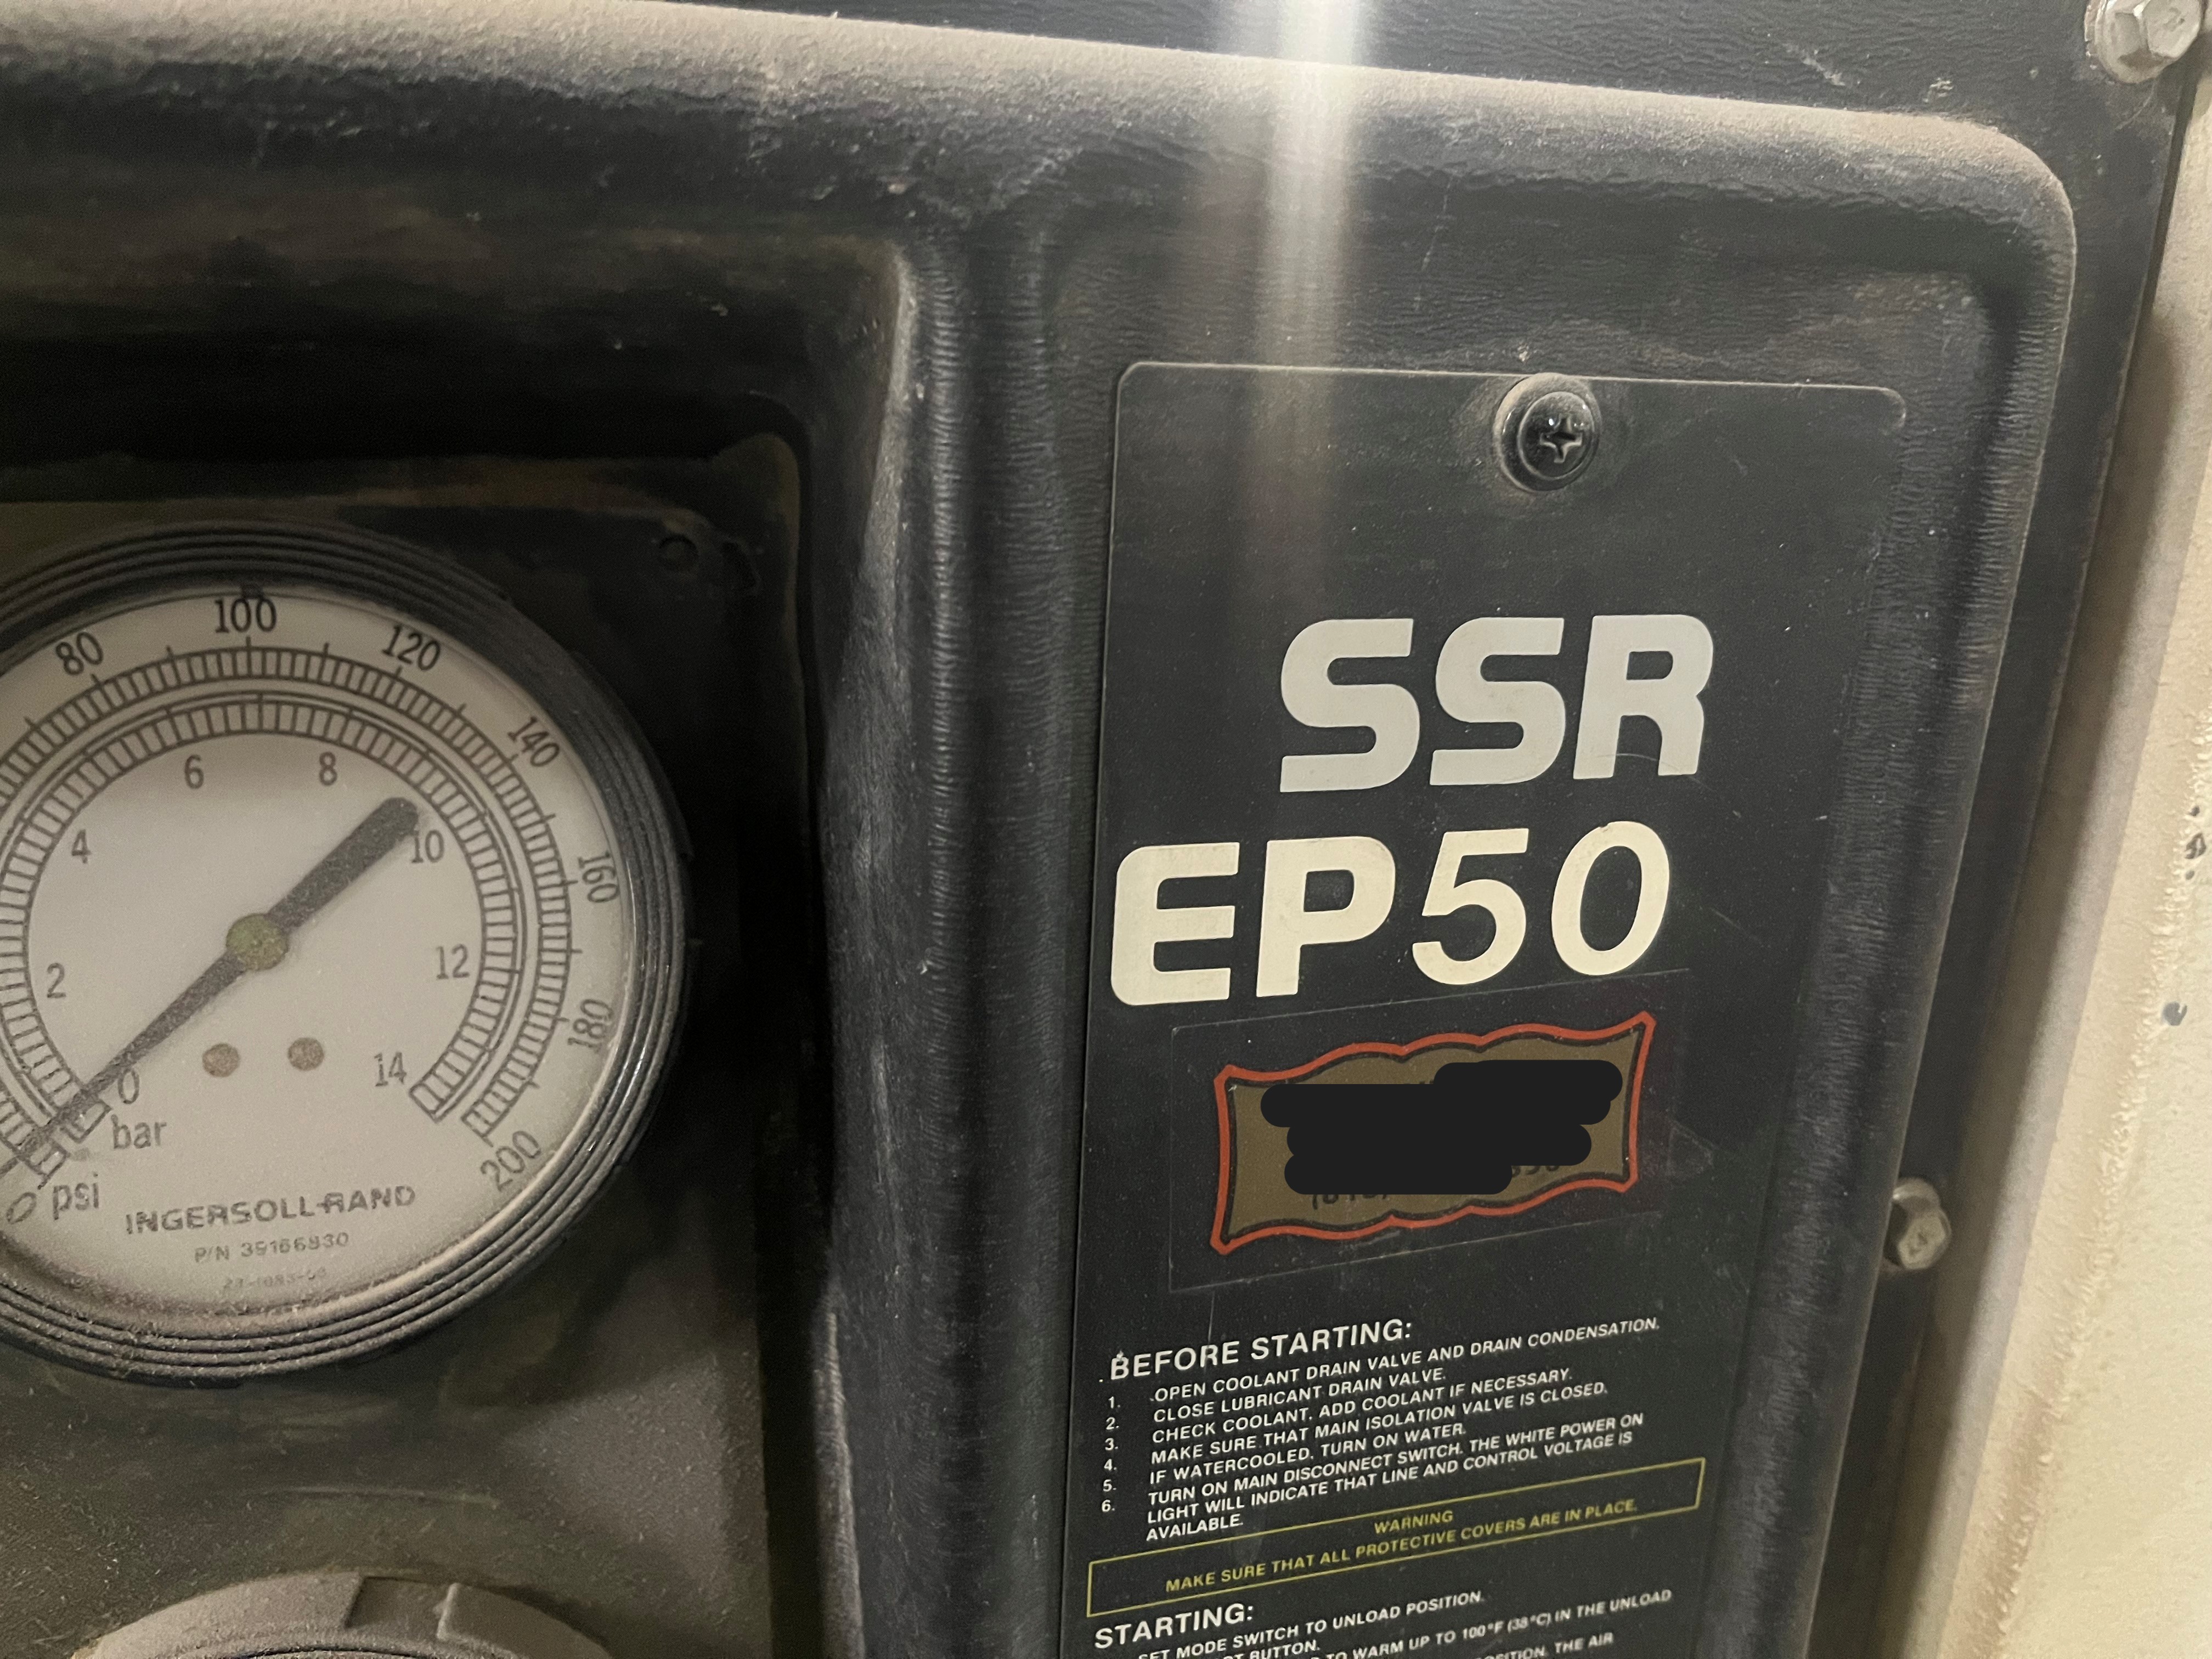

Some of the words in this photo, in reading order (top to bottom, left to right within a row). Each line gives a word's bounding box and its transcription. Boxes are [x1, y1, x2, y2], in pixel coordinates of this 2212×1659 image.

[215, 597, 275, 634] 100
[56, 631, 104, 675] 80
[382, 625, 441, 670] 120
[1280, 614, 1714, 792] SSR
[507, 716, 560, 767] 140
[184, 754, 204, 789] 6
[318, 752, 338, 786] 8
[71, 830, 91, 864] 4
[411, 830, 444, 864] 10
[578, 851, 619, 904] 160
[1110, 821, 1671, 1006] EP50
[46, 963, 66, 998] 2
[436, 944, 470, 979] 12
[567, 998, 613, 1050] 180
[117, 1068, 140, 1104] 0
[374, 1052, 405, 1087] 14
[111, 1115, 166, 1149] bar
[481, 1130, 542, 1192] 200
[6, 1192, 36, 1224] 0
[53, 1172, 99, 1221] psi
[1108, 1397, 1120, 1408] 1.
[1154, 1383, 1206, 1402] OPEN
[1214, 1369, 1299, 1392] COOLANT
[1307, 1358, 1360, 1378] DRAIN
[1368, 1351, 1421, 1370] VALVE
[1427, 1345, 1464, 1362] AND
[1471, 1336, 1522, 1356] DRAIN
[1528, 1317, 1660, 1347] CONDENSATION.
[1110, 1341, 1239, 1380] BEFORE
[1251, 1319, 1412, 1360] STARTING:
[1105, 1438, 1118, 1451] 3.
[1153, 1422, 1215, 1443] CHECK
[1223, 1408, 1312, 1433] COOLANT.
[1320, 1400, 1356, 1418] ADD
[1362, 1386, 1445, 1411] COOLANT
[1450, 1385, 1465, 1398] IF
[1471, 1368, 1572, 1393] NECESSARY.
[1106, 1417, 1119, 1430] 2.
[1154, 1402, 1215, 1423] CLOSE
[1222, 1386, 1322, 1413] LUBRICANT
[1329, 1375, 1381, 1396] DRAIN
[1389, 1368, 1446, 1387] VALVE.
[1104, 1459, 1116, 1471] 4.
[1152, 1444, 1203, 1464] MAKE
[1210, 1436, 1257, 1455] SURE
[1264, 1427, 1308, 1446] THAT
[1315, 1419, 1359, 1438] MAIN
[1365, 1406, 1455, 1430] ISOLATION
[1462, 1397, 1514, 1415] VALVE
[1520, 1393, 1535, 1407] IS
[1541, 1381, 1607, 1403] CLOSED.
[1101, 1500, 1115, 1513] 6.
[1149, 1486, 1195, 1505] TURN
[1202, 1481, 1227, 1497] ON
[1234, 1472, 1278, 1492] MAIN
[1284, 1453, 1393, 1483] DISCONNECT
[1397, 1443, 1463, 1466] SWITCH.
[1469, 1436, 1500, 1453] THE
[1506, 1427, 1555, 1447] WHITE
[1560, 1418, 1615, 1438] POWER
[1620, 1413, 1644, 1427] ON
[1103, 1480, 1116, 1492] 5.
[1150, 1471, 1167, 1485] IF
[1321, 1438, 1367, 1458] TURN
[1373, 1433, 1398, 1448] ON
[1405, 1423, 1466, 1446] WATER.
[1148, 1503, 1199, 1523] LIGHT
[1206, 1498, 1245, 1513] WILL
[1251, 1482, 1328, 1507] INDICATE
[1334, 1474, 1378, 1493] THAT
[1382, 1467, 1418, 1484] LINE
[1423, 1459, 1458, 1477] AND
[1464, 1448, 1538, 1470] CONTROL
[1544, 1435, 1613, 1456] VOLTAGE
[1618, 1431, 1633, 1445] IS
[1146, 1514, 1243, 1541] AVAILABLE.
[1374, 1511, 1453, 1534] WARNING
[1165, 1573, 1215, 1592] MAKE
[1221, 1564, 1266, 1582] SURE
[1272, 1555, 1314, 1573] THAT
[1320, 1549, 1350, 1563] ALL
[1356, 1529, 1456, 1559] PROTECTIVE
[1462, 1518, 1525, 1540] COVERS
[1530, 1511, 1560, 1528] ARE
[1565, 1509, 1581, 1522] IN
[1094, 1602, 1254, 1649] STARTING:
[1176, 1638, 1227, 1658] MODE
[1233, 1624, 1299, 1648] SWITCH
[1306, 1620, 1327, 1635] TO
[1333, 1606, 1400, 1630] UNLOAD
[1352, 1640, 1403, 1659] WARM
[1409, 1636, 1429, 1650] UP
[1436, 1631, 1455, 1645] TO
[1555, 1608, 1571, 1621] IN
[1577, 1601, 1606, 1617] THE
[1610, 1589, 1672, 1612] UNLOAD
[1554, 1638, 1584, 1654] THE
[1588, 1632, 1613, 1647] AIR
